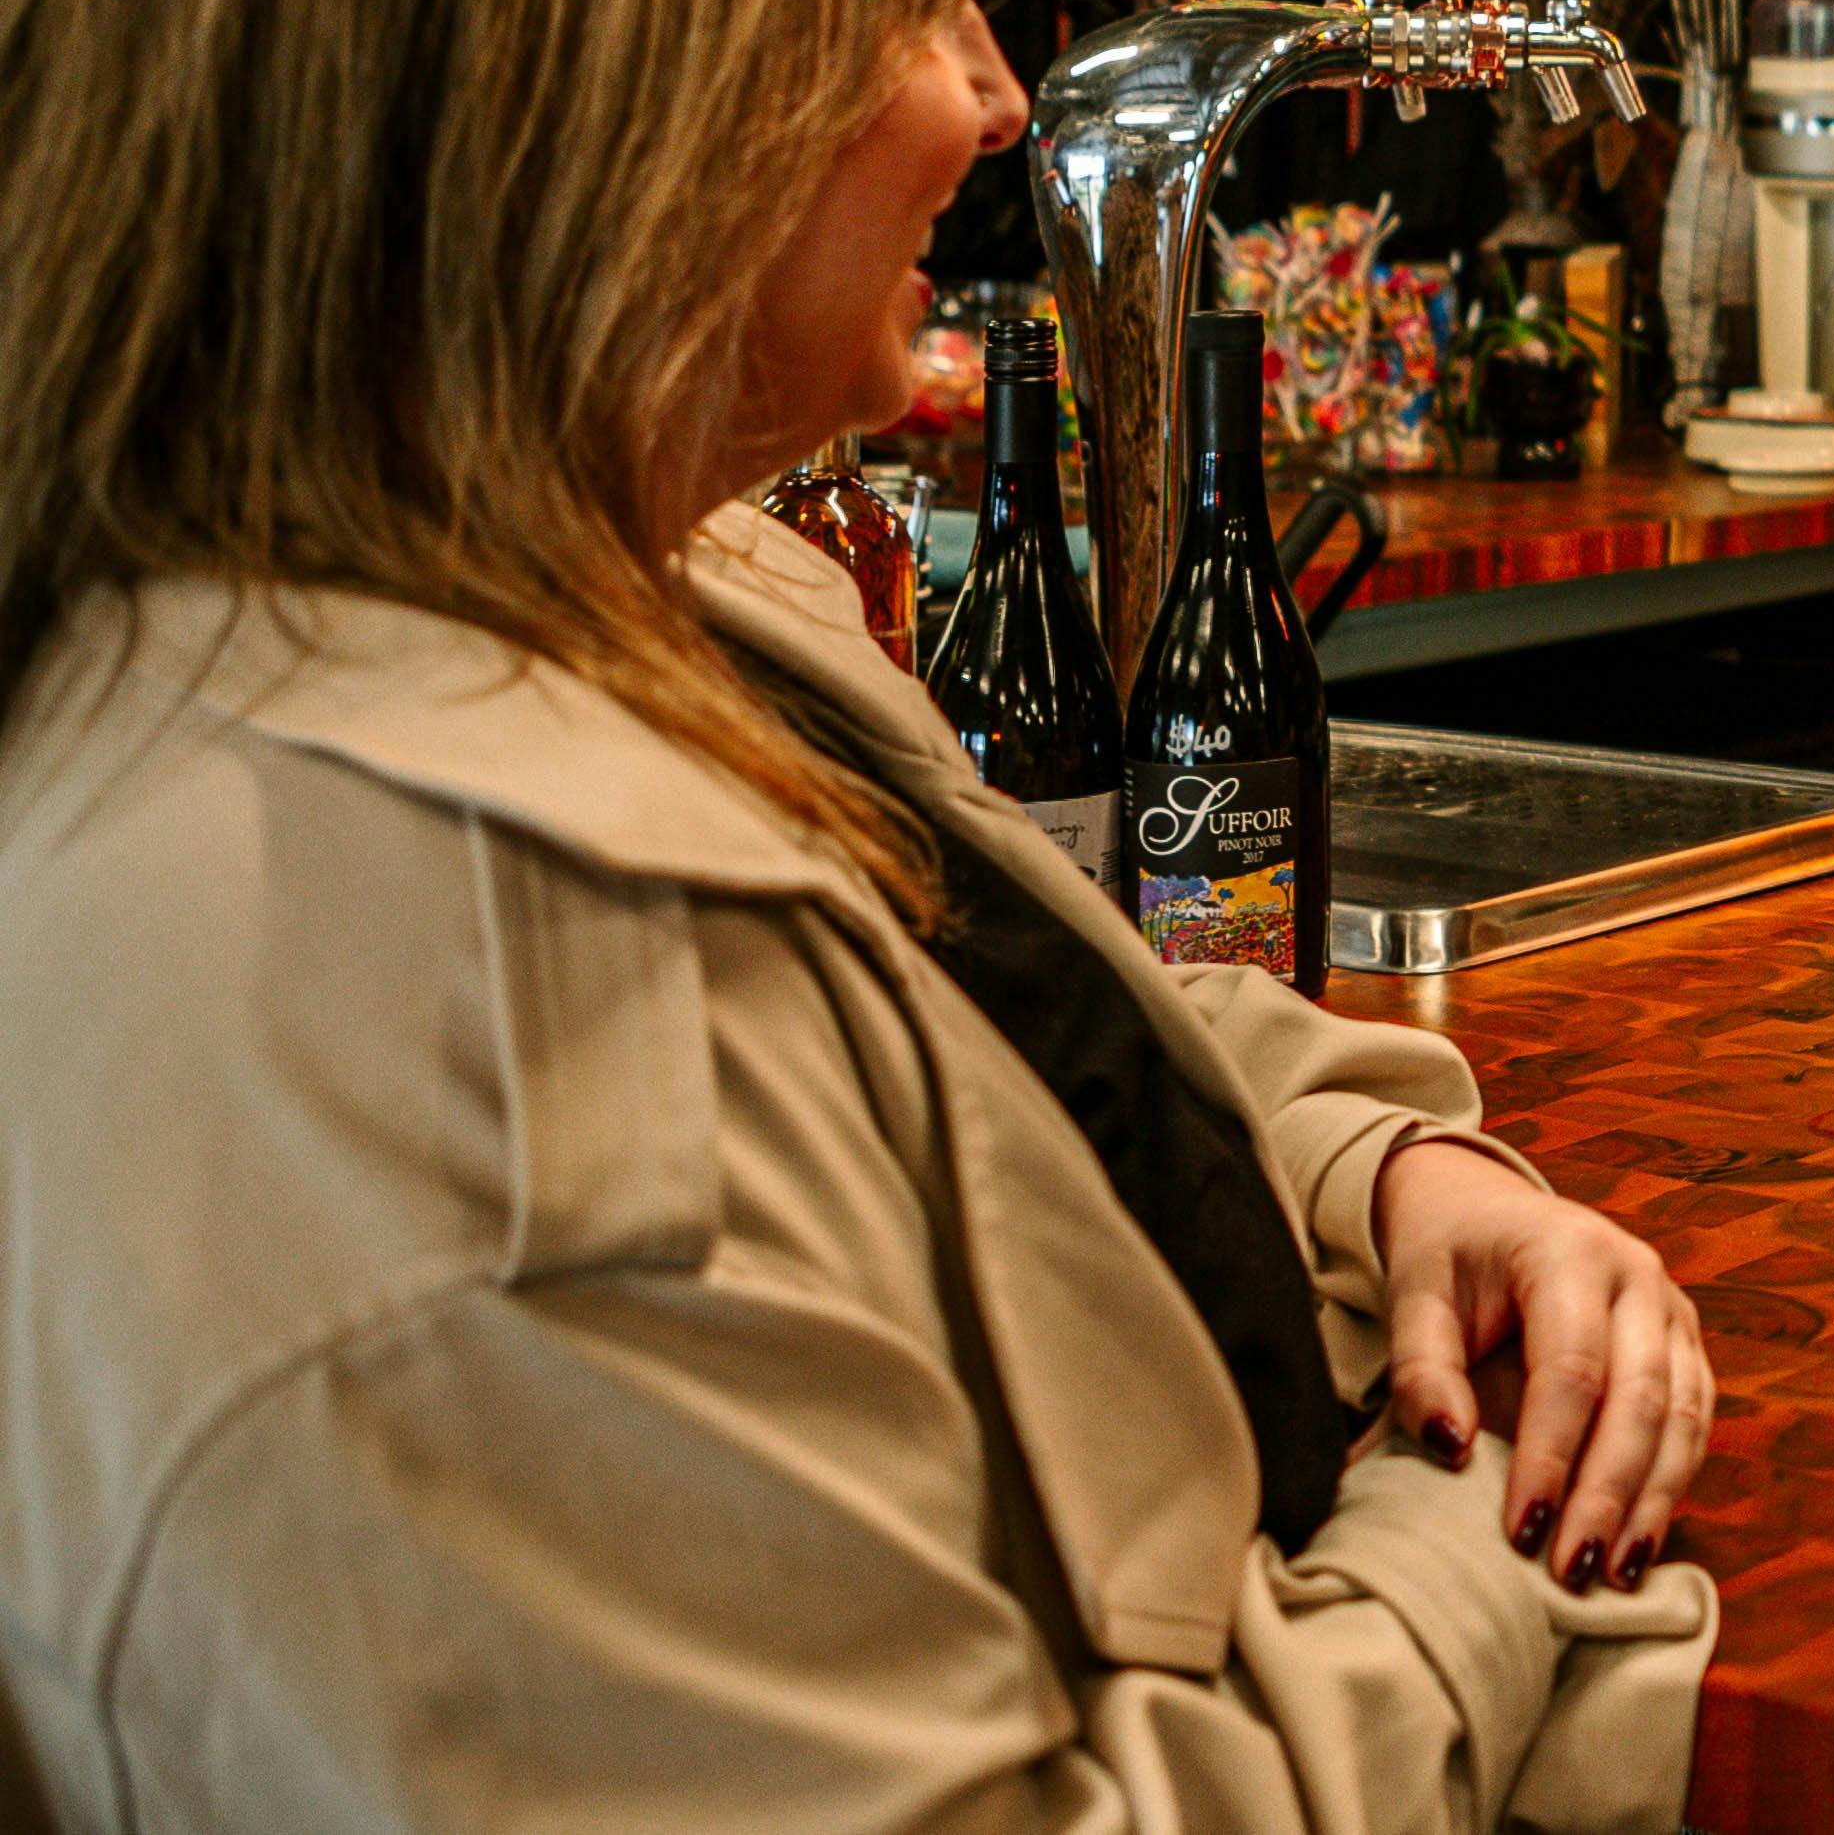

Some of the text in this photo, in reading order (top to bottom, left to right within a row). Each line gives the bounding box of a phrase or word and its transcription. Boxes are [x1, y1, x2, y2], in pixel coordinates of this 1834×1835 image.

[1165, 713, 1232, 759] $40
[1217, 834, 1283, 852] PINOT NOIR
[1242, 850, 1265, 865] 2017
